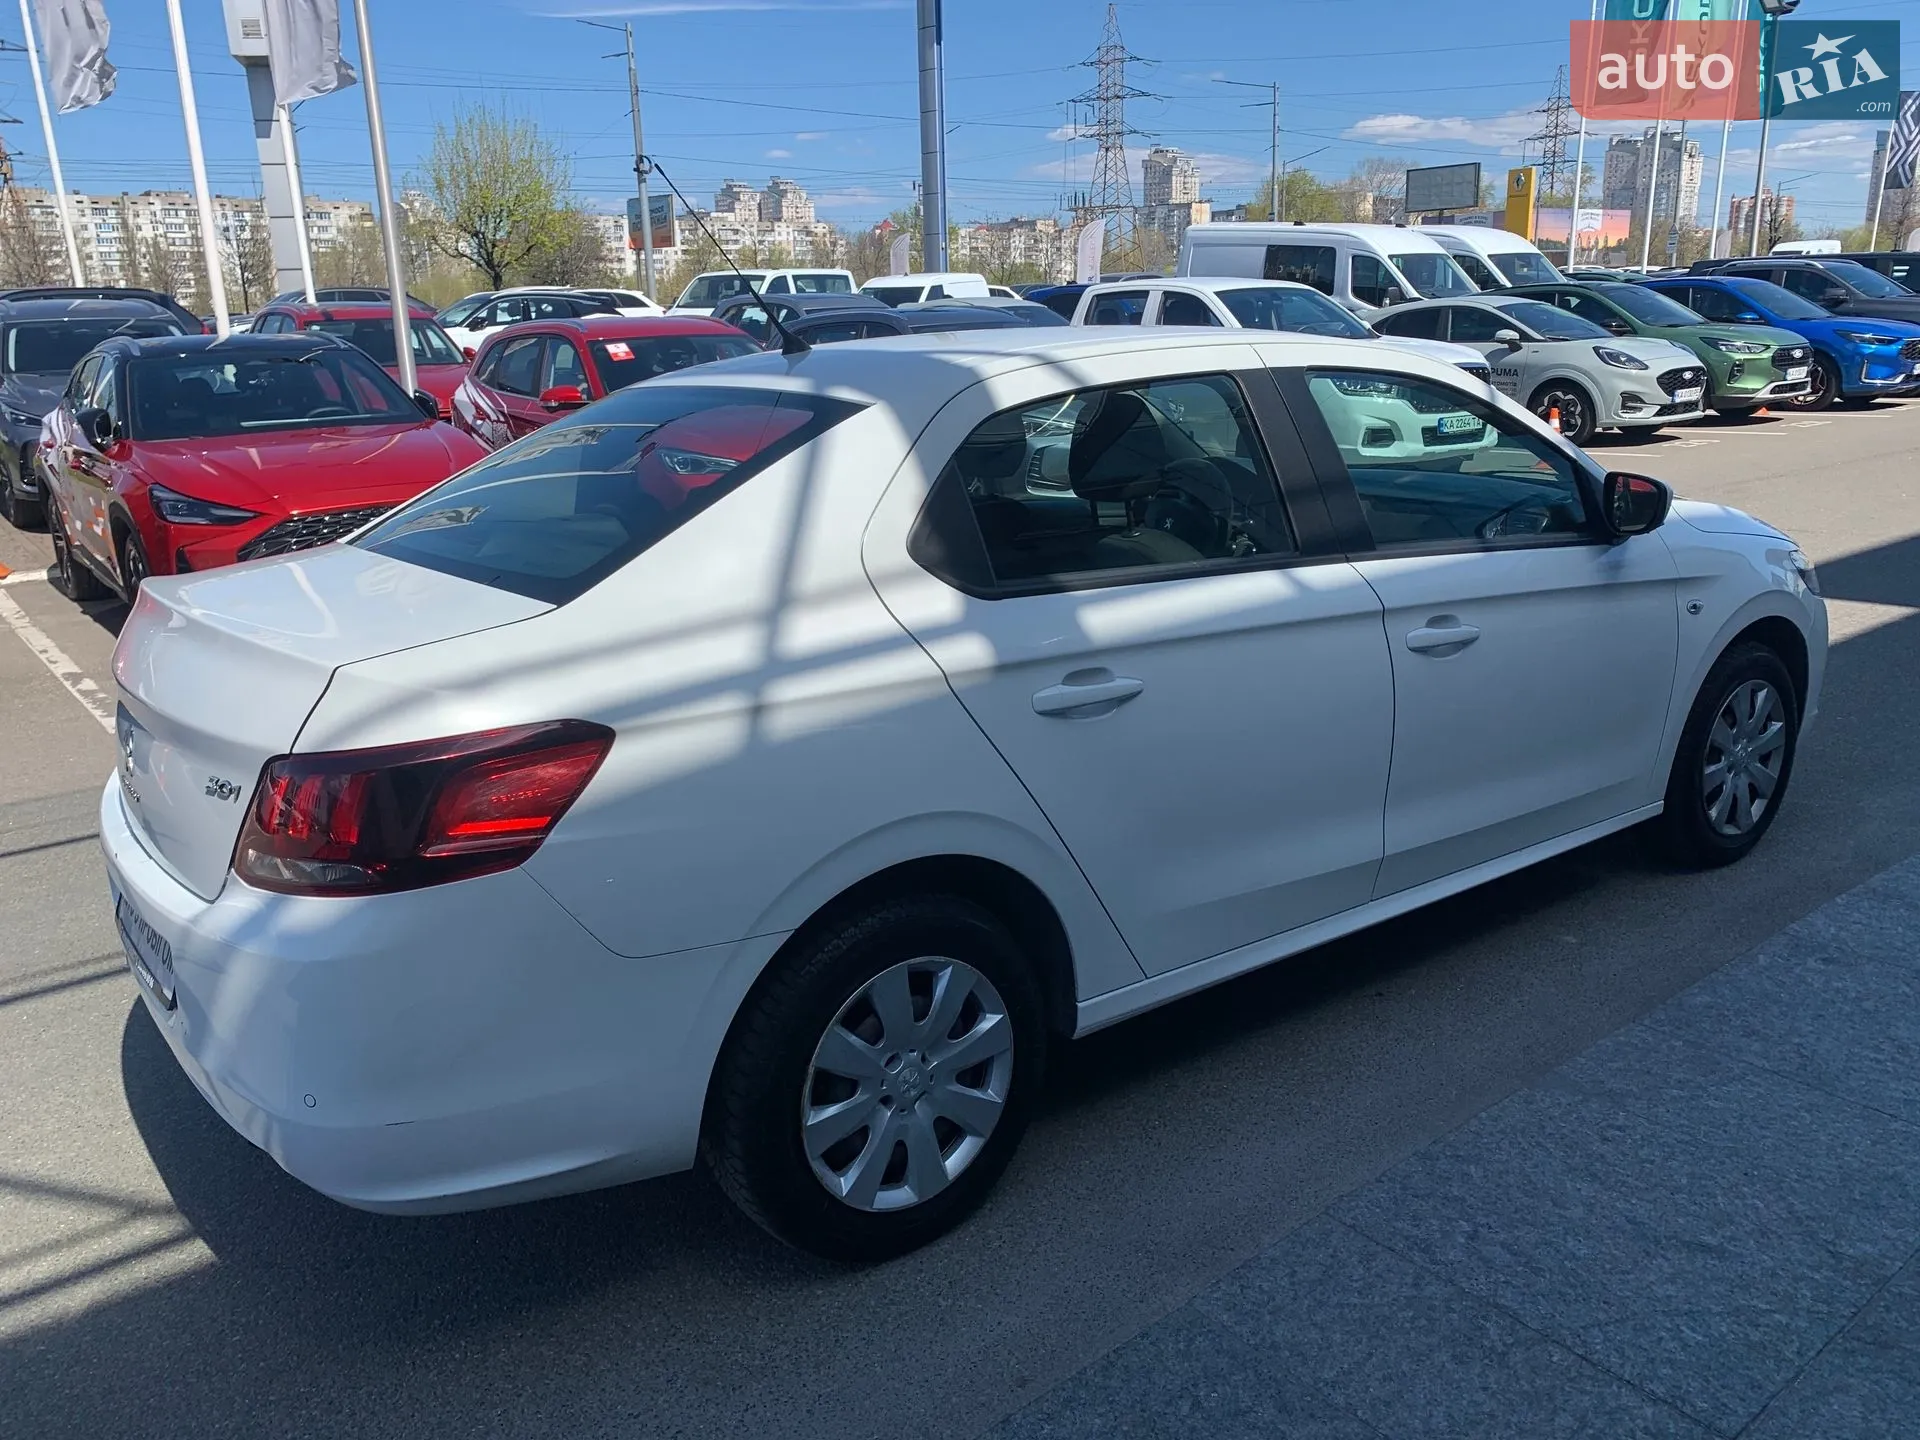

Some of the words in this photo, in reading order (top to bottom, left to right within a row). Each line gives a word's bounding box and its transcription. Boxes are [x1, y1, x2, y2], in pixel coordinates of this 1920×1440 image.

[1491, 367, 1519, 377] PUMA
[1443, 419, 1455, 430] KA
[1455, 418, 1471, 428] 2264
[205, 775, 242, 804] 301
